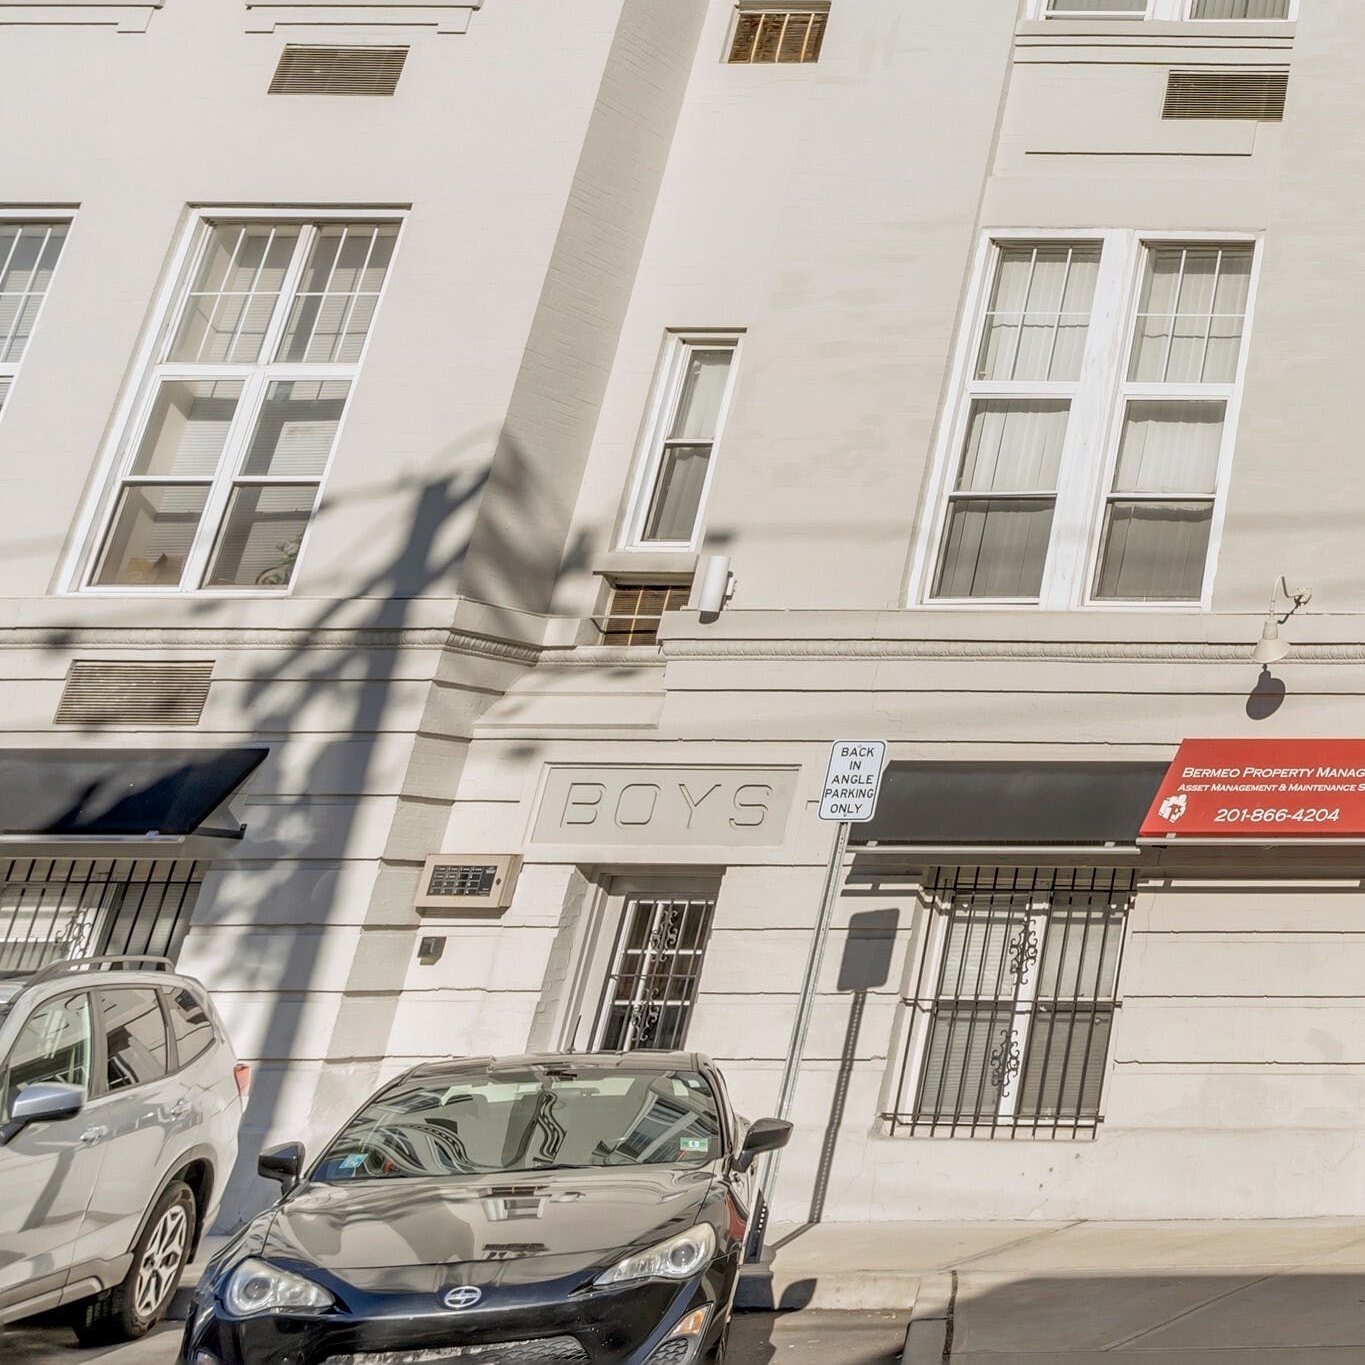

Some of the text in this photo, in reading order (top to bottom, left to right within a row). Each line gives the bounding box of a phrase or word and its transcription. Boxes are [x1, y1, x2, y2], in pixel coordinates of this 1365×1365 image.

[841, 747, 875, 757] BACK
[849, 760, 862, 771] IN
[1181, 767, 1240, 778] BERMEO
[1242, 767, 1314, 778] PROPERTY
[831, 774, 874, 785] ANGLE
[824, 788, 874, 799] PARKING
[1176, 784, 1210, 792] ASSET
[1210, 784, 1277, 792] MANAGEMENT
[1278, 784, 1287, 792] &
[1287, 784, 1356, 792] MAINTENANCE
[560, 782, 773, 830] BOYS
[830, 803, 863, 814] ONLY
[1213, 808, 1340, 822] 201-866-4204
